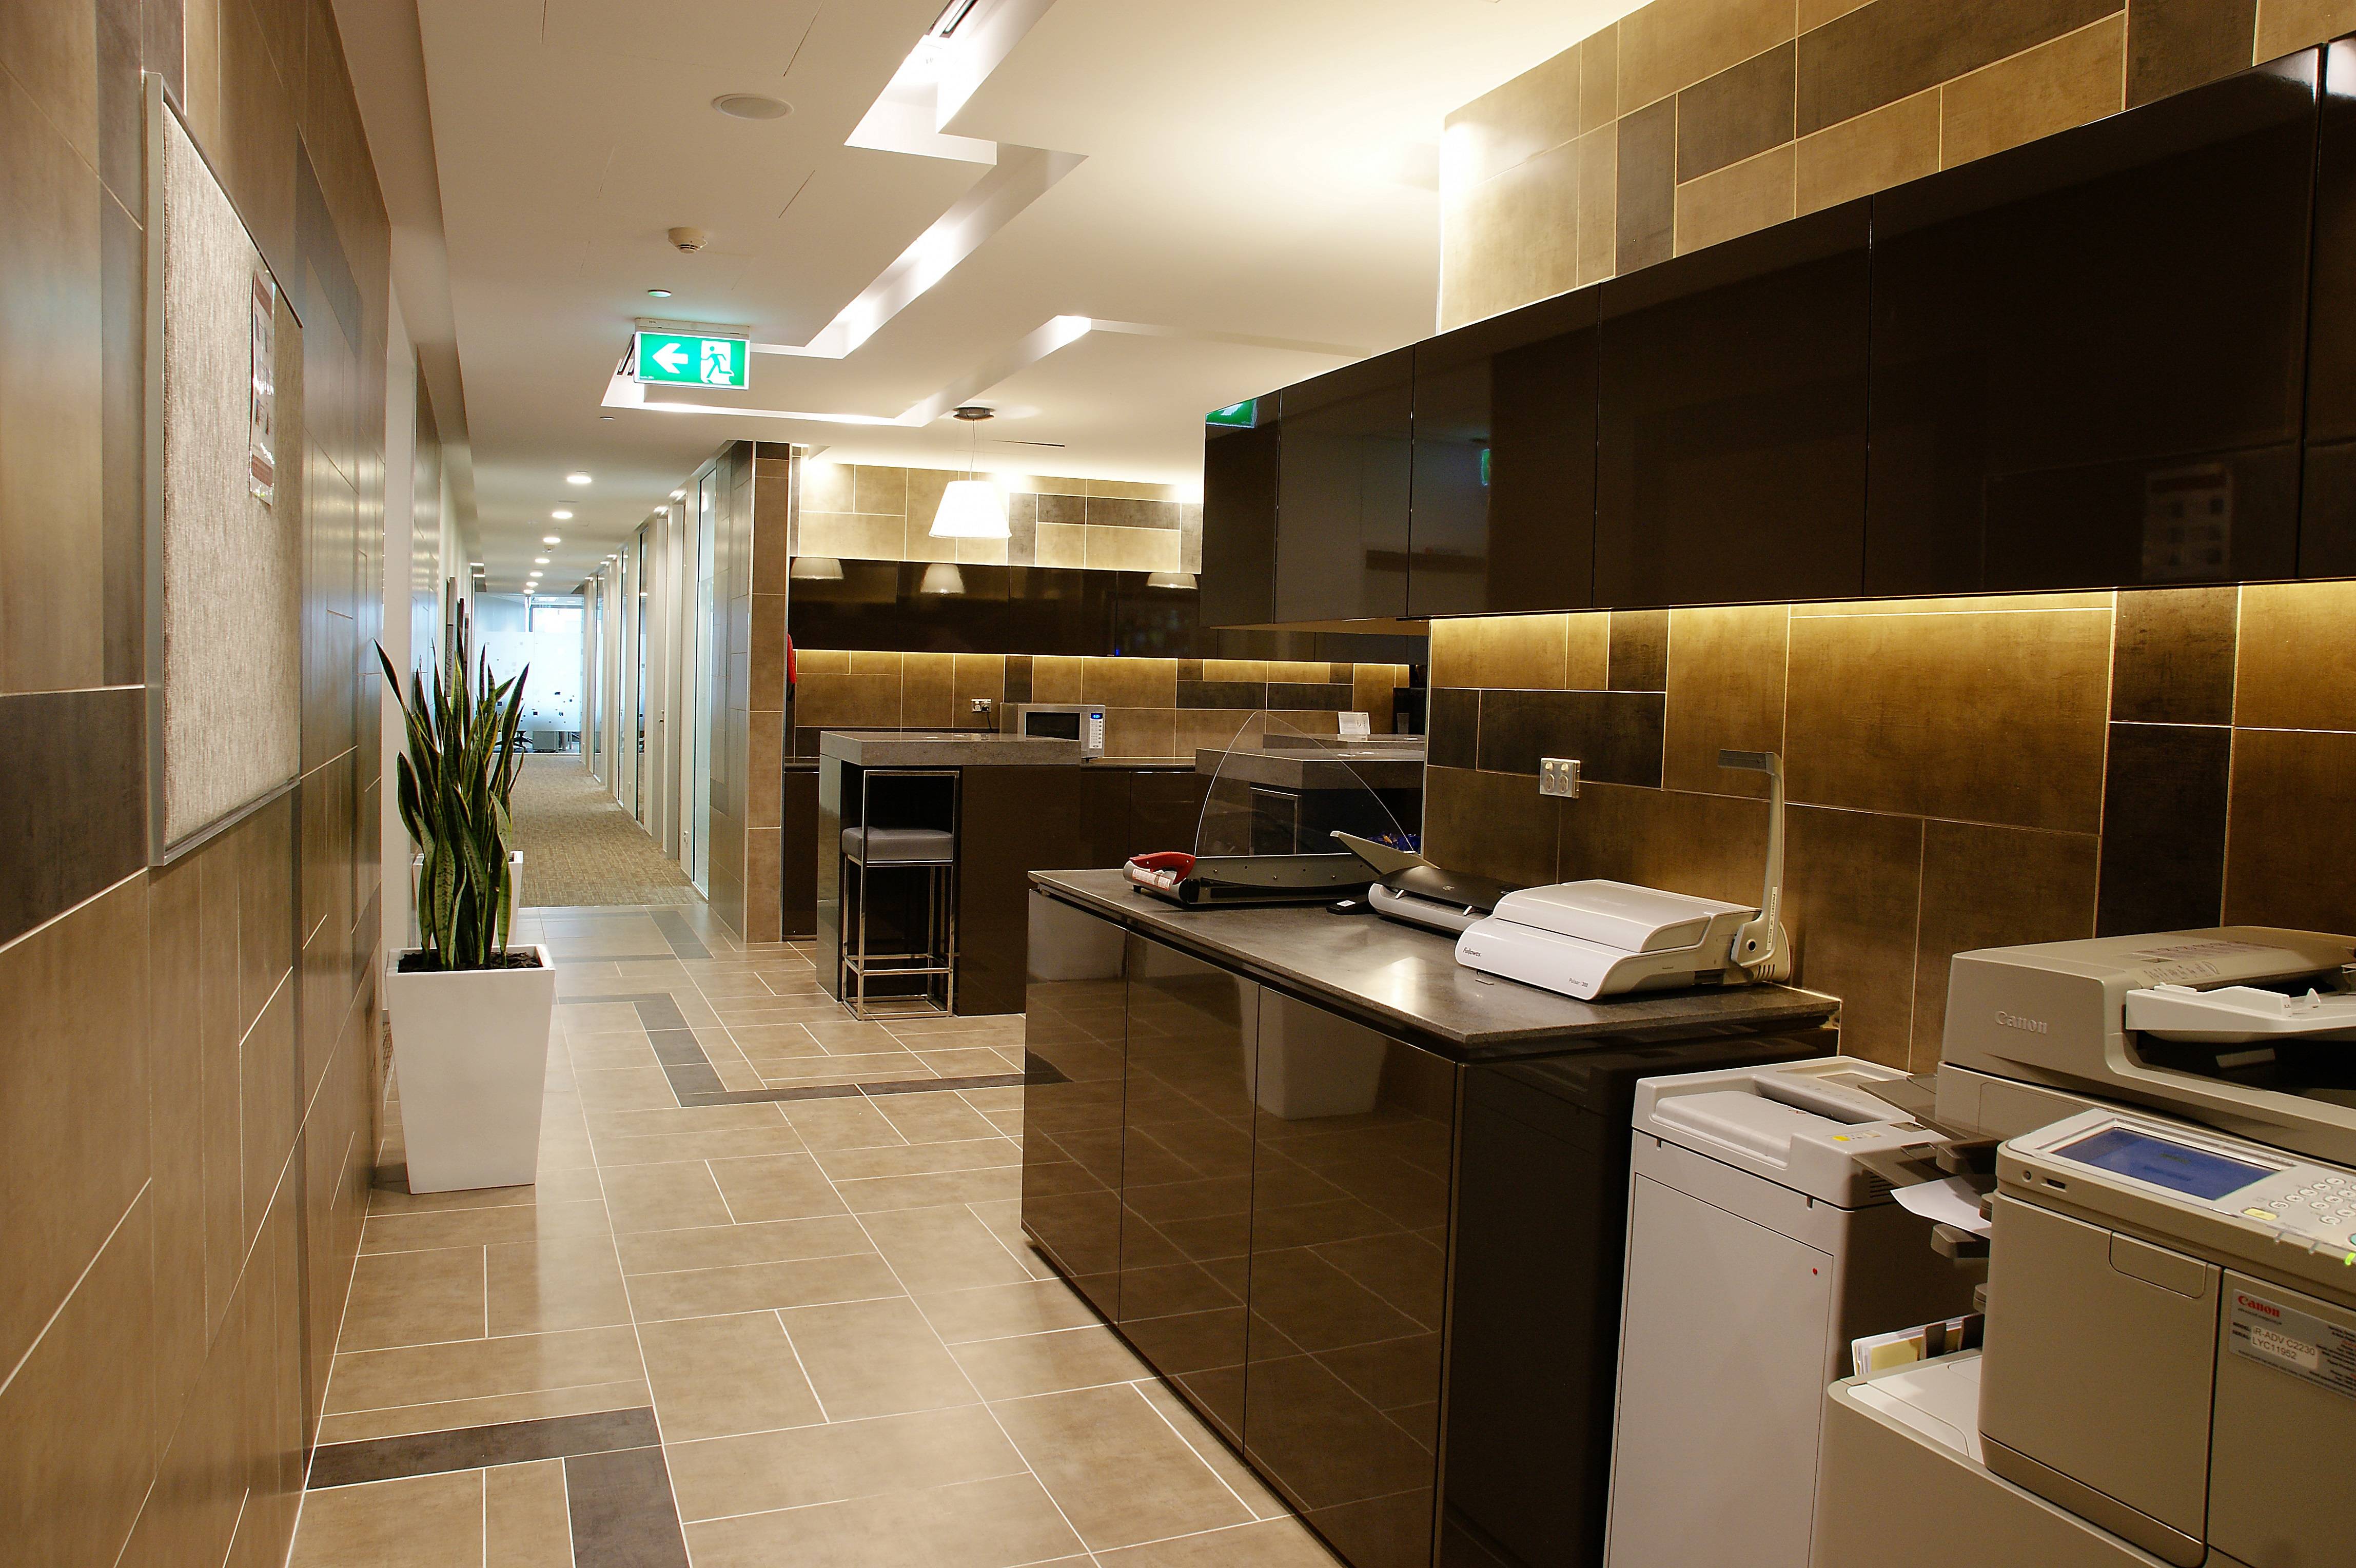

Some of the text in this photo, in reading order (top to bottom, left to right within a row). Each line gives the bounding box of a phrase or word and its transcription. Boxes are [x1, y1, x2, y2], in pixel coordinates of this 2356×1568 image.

[1995, 1011, 2048, 1035] Canon
[2238, 1295, 2280, 1317] Canon
[2252, 1337, 2296, 1359] LYC11952
[2286, 1339, 2315, 1356] C2230
